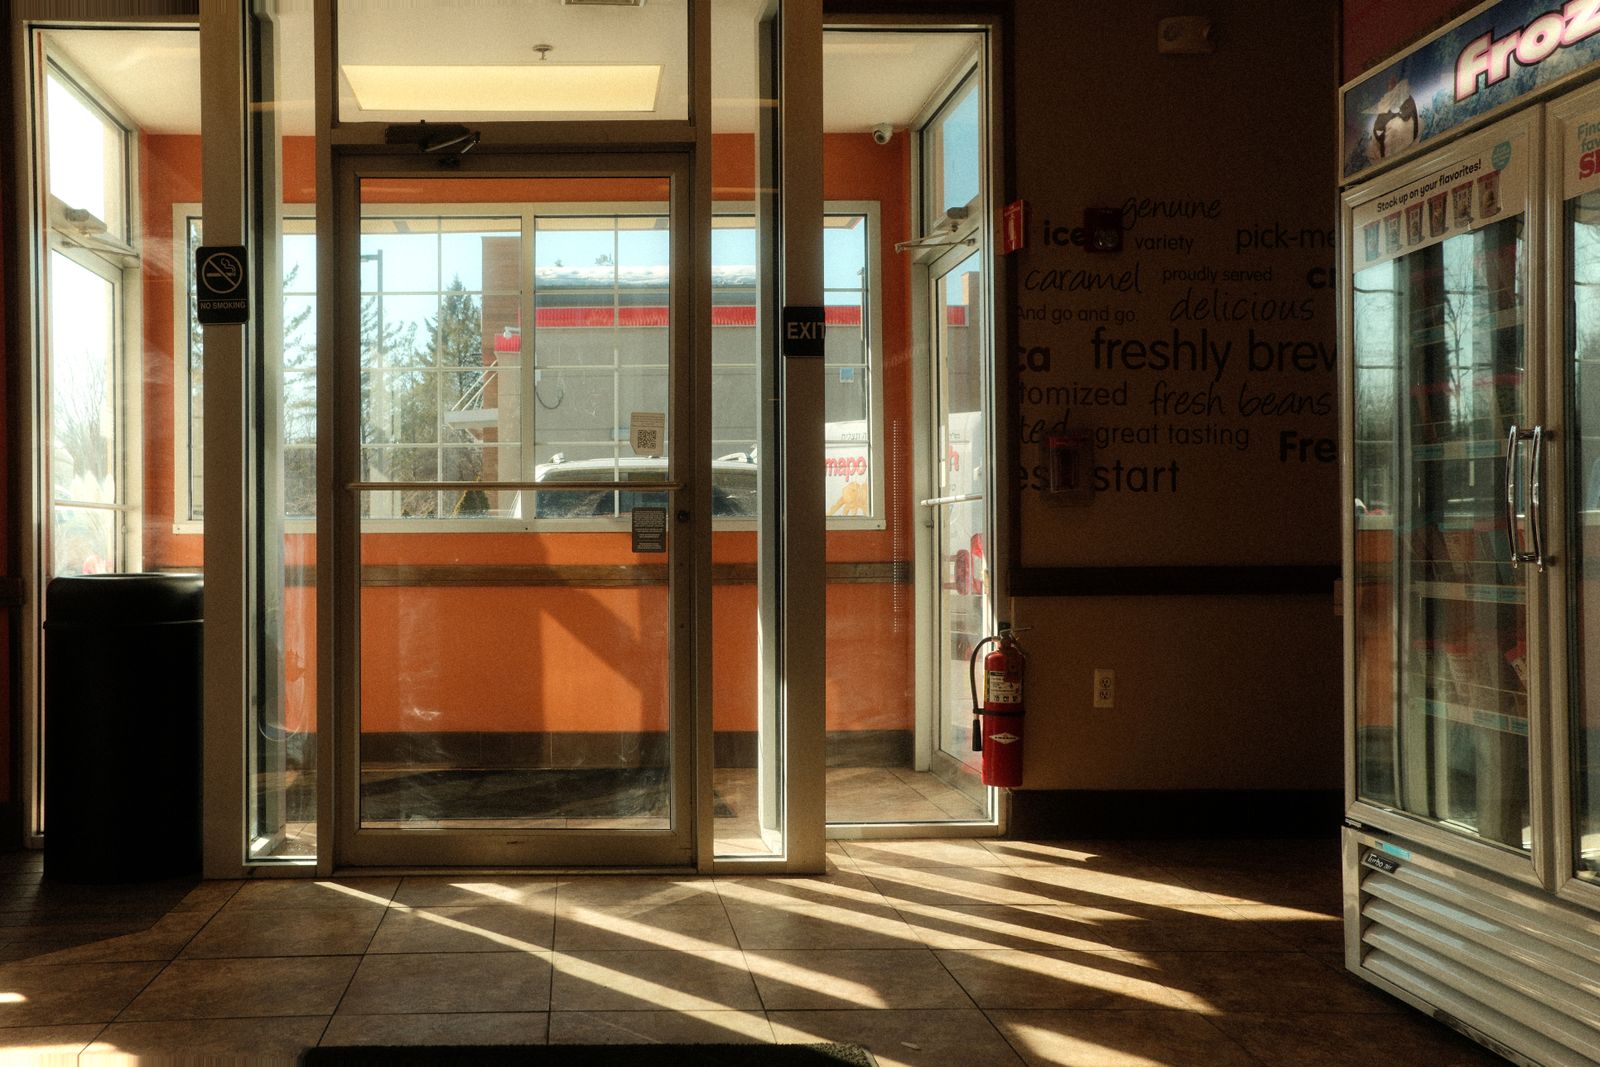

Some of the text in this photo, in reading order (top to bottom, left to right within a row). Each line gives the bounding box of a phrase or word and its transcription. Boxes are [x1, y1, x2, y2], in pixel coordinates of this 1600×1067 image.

[1377, 158, 1482, 212] Stock up on your flavorites!
[1121, 194, 1221, 231] genuine
[1043, 219, 1089, 246] ice
[1135, 234, 1194, 254] variety
[1024, 261, 1142, 293] caramel
[1162, 265, 1273, 284] proudly served
[213, 301, 246, 309] SMOKING
[1051, 308, 1073, 325] go
[1078, 304, 1109, 321] and
[1169, 286, 1315, 322] delicious
[787, 321, 825, 340] EXIT
[1090, 326, 1232, 382] freshly
[1149, 379, 1332, 417] fresh beans
[1095, 423, 1249, 450] great tasting
[1093, 459, 1180, 493] start
